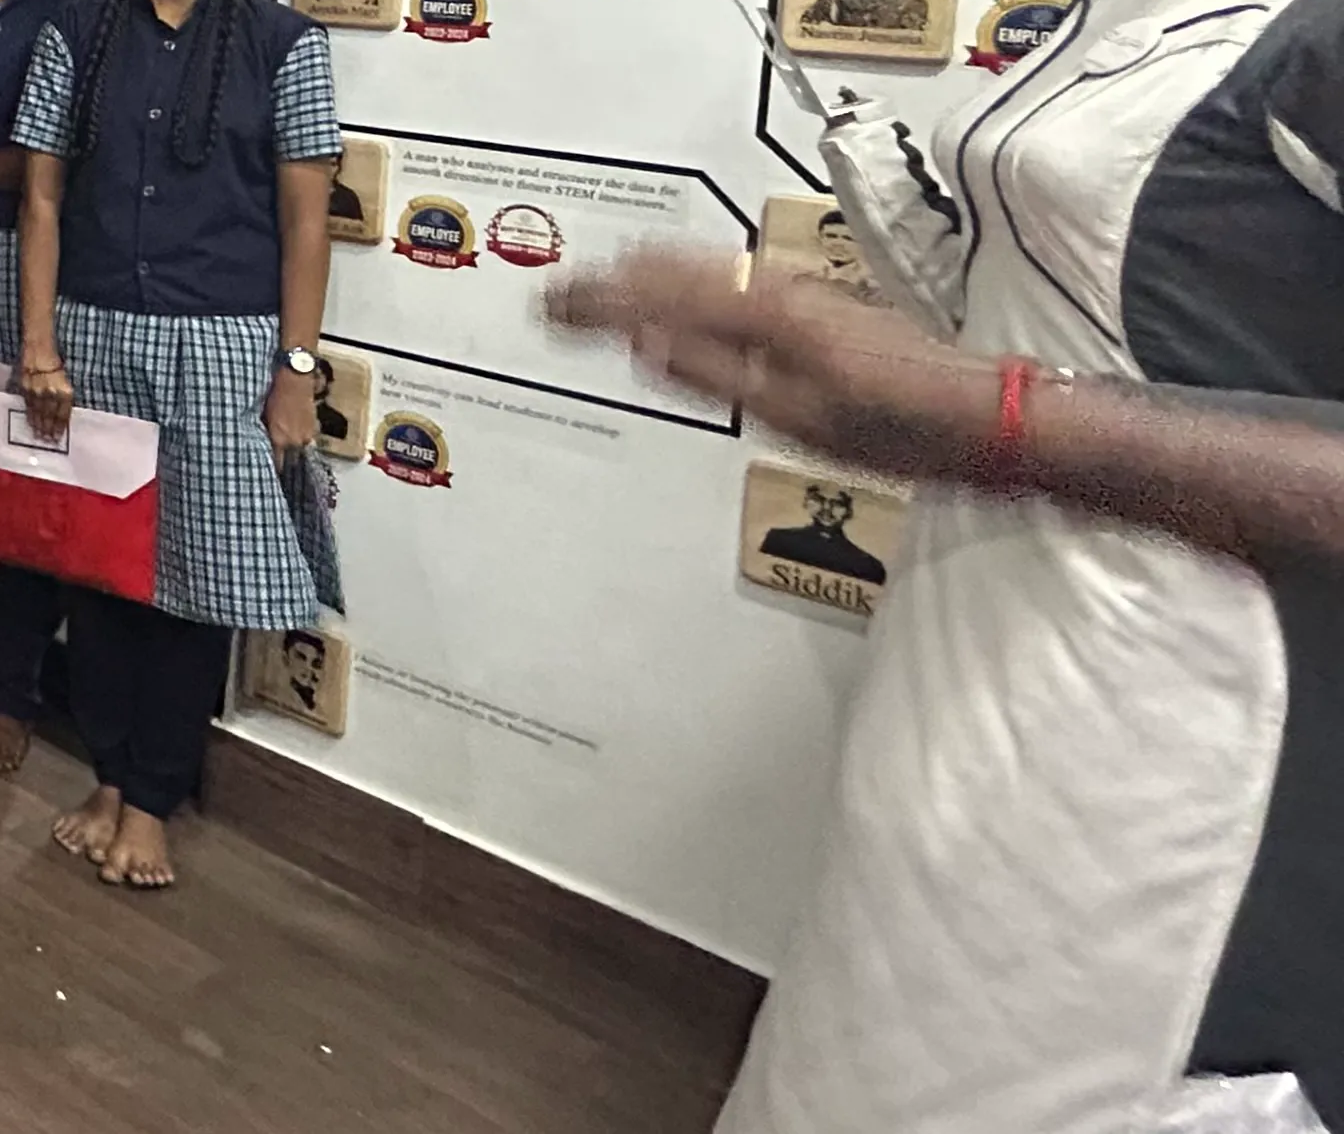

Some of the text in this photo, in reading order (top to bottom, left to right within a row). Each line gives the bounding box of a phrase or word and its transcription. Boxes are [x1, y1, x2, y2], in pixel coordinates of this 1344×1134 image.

[422, 0, 475, 17] EMPLOYEE
[998, 27, 1056, 45] EMPLO
[403, 150, 682, 198] A man who analyses and structures the data for
[443, 168, 500, 187] directions
[516, 178, 553, 196] future
[554, 183, 596, 202] STEM
[411, 222, 462, 245] EMPLOYEE
[382, 373, 400, 388] My
[401, 378, 452, 399] creativity
[453, 391, 476, 404] can
[387, 439, 437, 462] EMPLOYEE
[770, 563, 875, 617] Siddik
